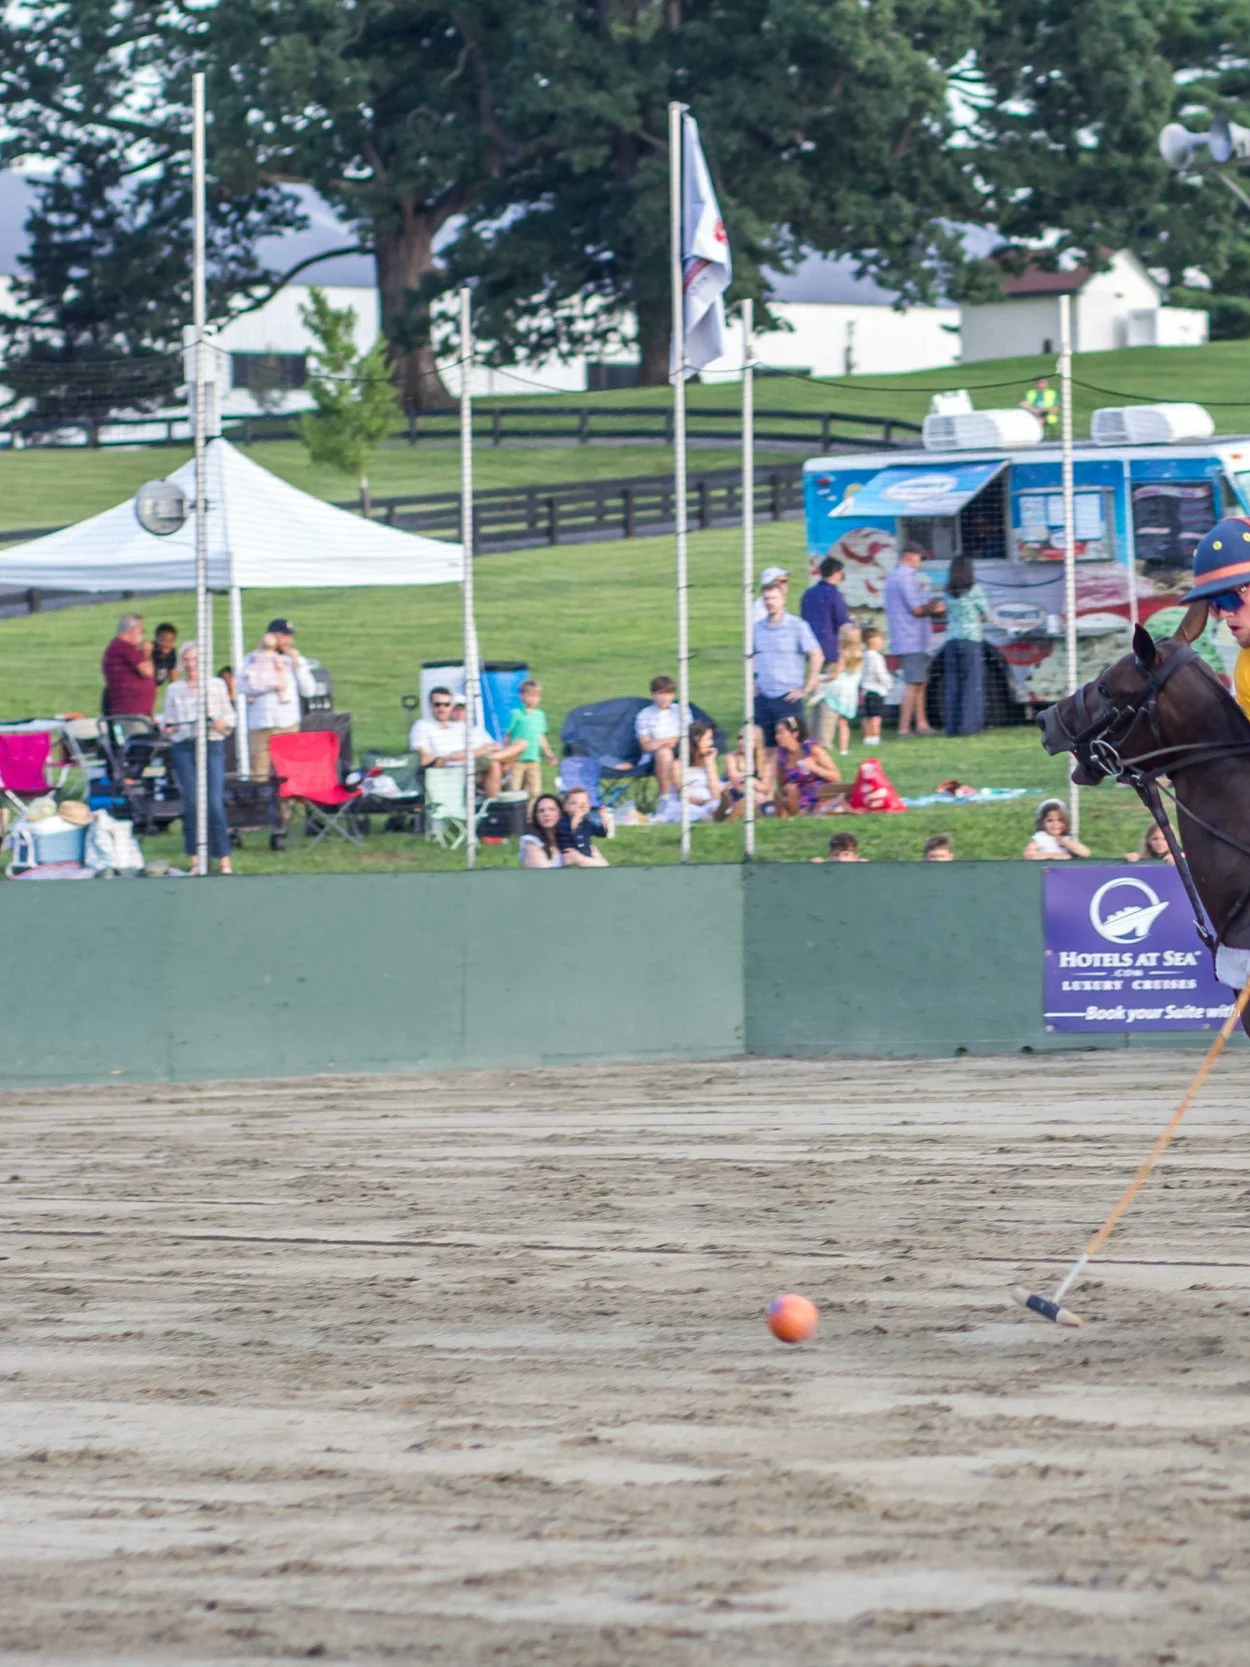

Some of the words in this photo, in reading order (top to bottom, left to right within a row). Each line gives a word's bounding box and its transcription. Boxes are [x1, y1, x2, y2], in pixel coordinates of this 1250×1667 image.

[1059, 951, 1133, 967] HOTELS
[1136, 952, 1158, 966] AT
[1062, 980, 1123, 991] LUXURY
[1131, 979, 1198, 990] CRUISES
[1086, 1006, 1126, 1020] Book
[1126, 1009, 1162, 1022] your
[1164, 1005, 1204, 1018] Suite
